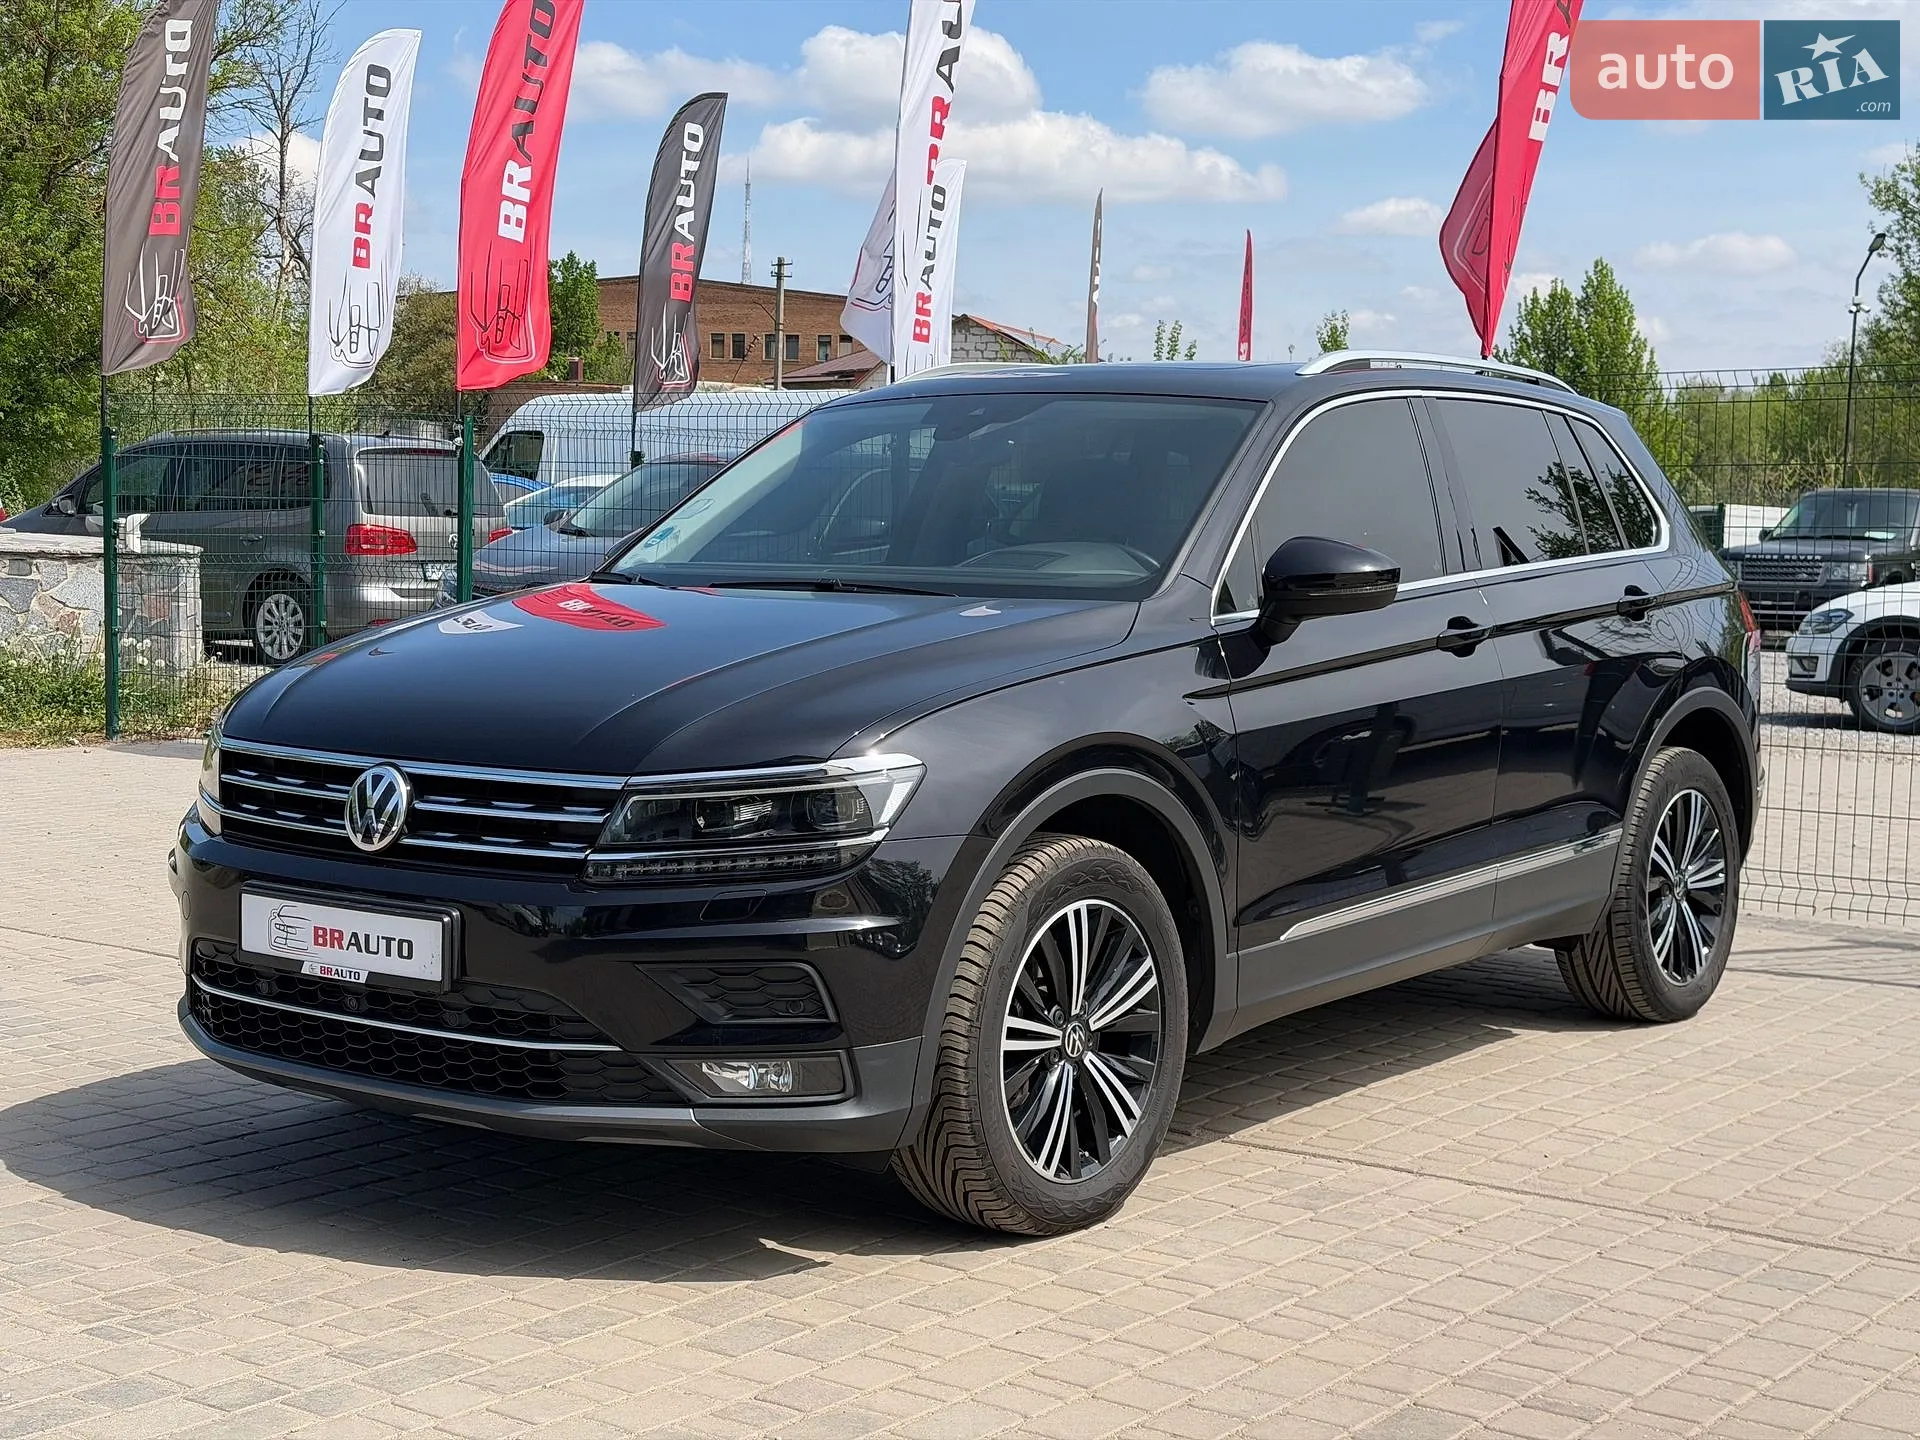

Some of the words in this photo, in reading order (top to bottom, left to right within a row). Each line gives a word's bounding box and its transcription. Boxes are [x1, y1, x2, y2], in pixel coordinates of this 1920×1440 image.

[149, 18, 194, 237] BRAUTO
[352, 63, 392, 270] BRAUTO
[498, 0, 556, 243] BRAUTO
[669, 121, 704, 303] BRAUTO
[911, 184, 947, 344] BRAUTO
[313, 925, 414, 961] BRAUTO
[319, 963, 361, 981] BRAUTO
